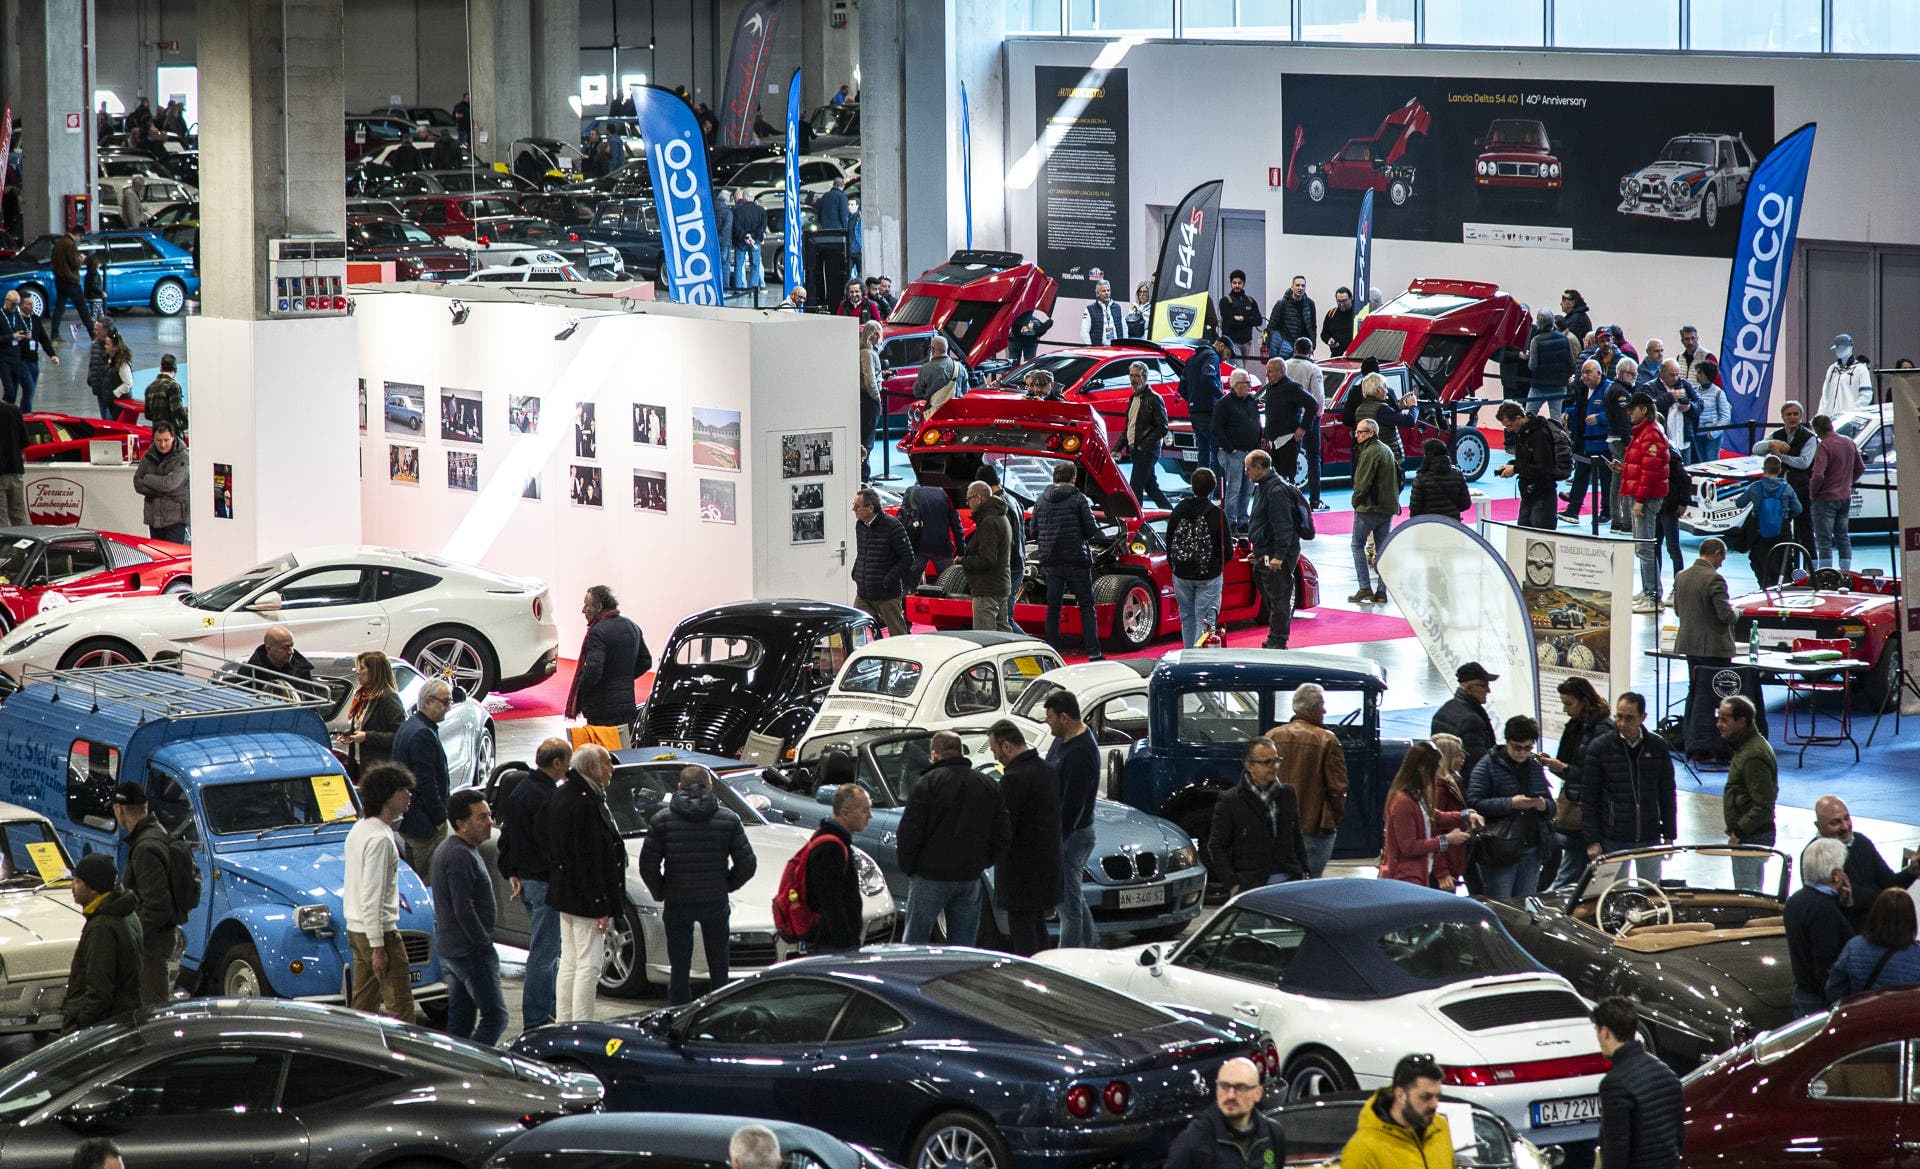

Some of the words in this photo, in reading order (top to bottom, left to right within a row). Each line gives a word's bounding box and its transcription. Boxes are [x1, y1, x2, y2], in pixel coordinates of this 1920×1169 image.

[1448, 92, 1472, 103] Lancia
[1474, 93, 1494, 104] Delta
[1507, 94, 1518, 104] 40
[1542, 95, 1587, 109] Anniversary
[1731, 192, 1793, 397] sparco
[37, 484, 74, 497] Ferruccio
[30, 496, 80, 511] Lamborghini
